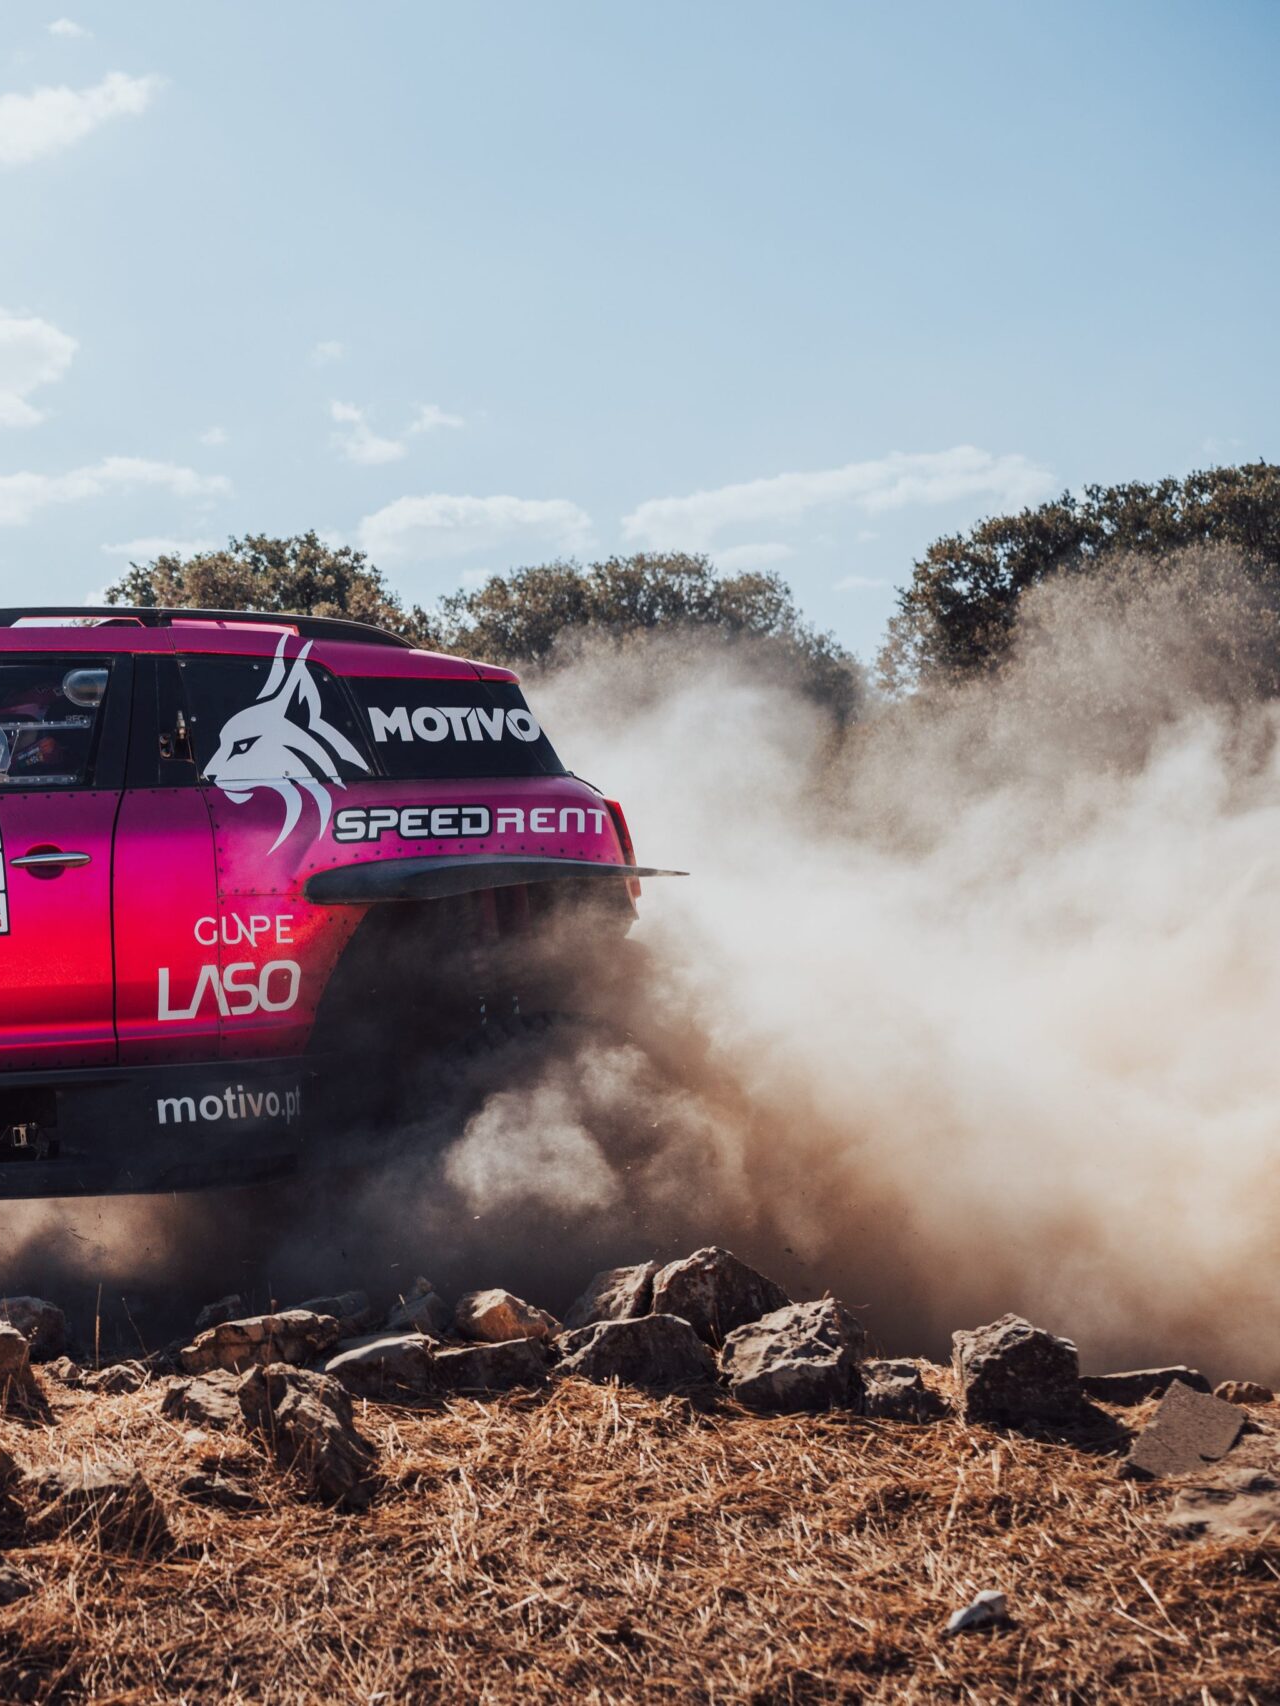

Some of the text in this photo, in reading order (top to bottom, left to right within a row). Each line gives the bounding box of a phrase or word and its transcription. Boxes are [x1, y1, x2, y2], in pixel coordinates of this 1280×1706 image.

[367, 706, 541, 742] MOTIVO
[157, 959, 302, 1021] LASO
[156, 1084, 301, 1124] motivo.pt
